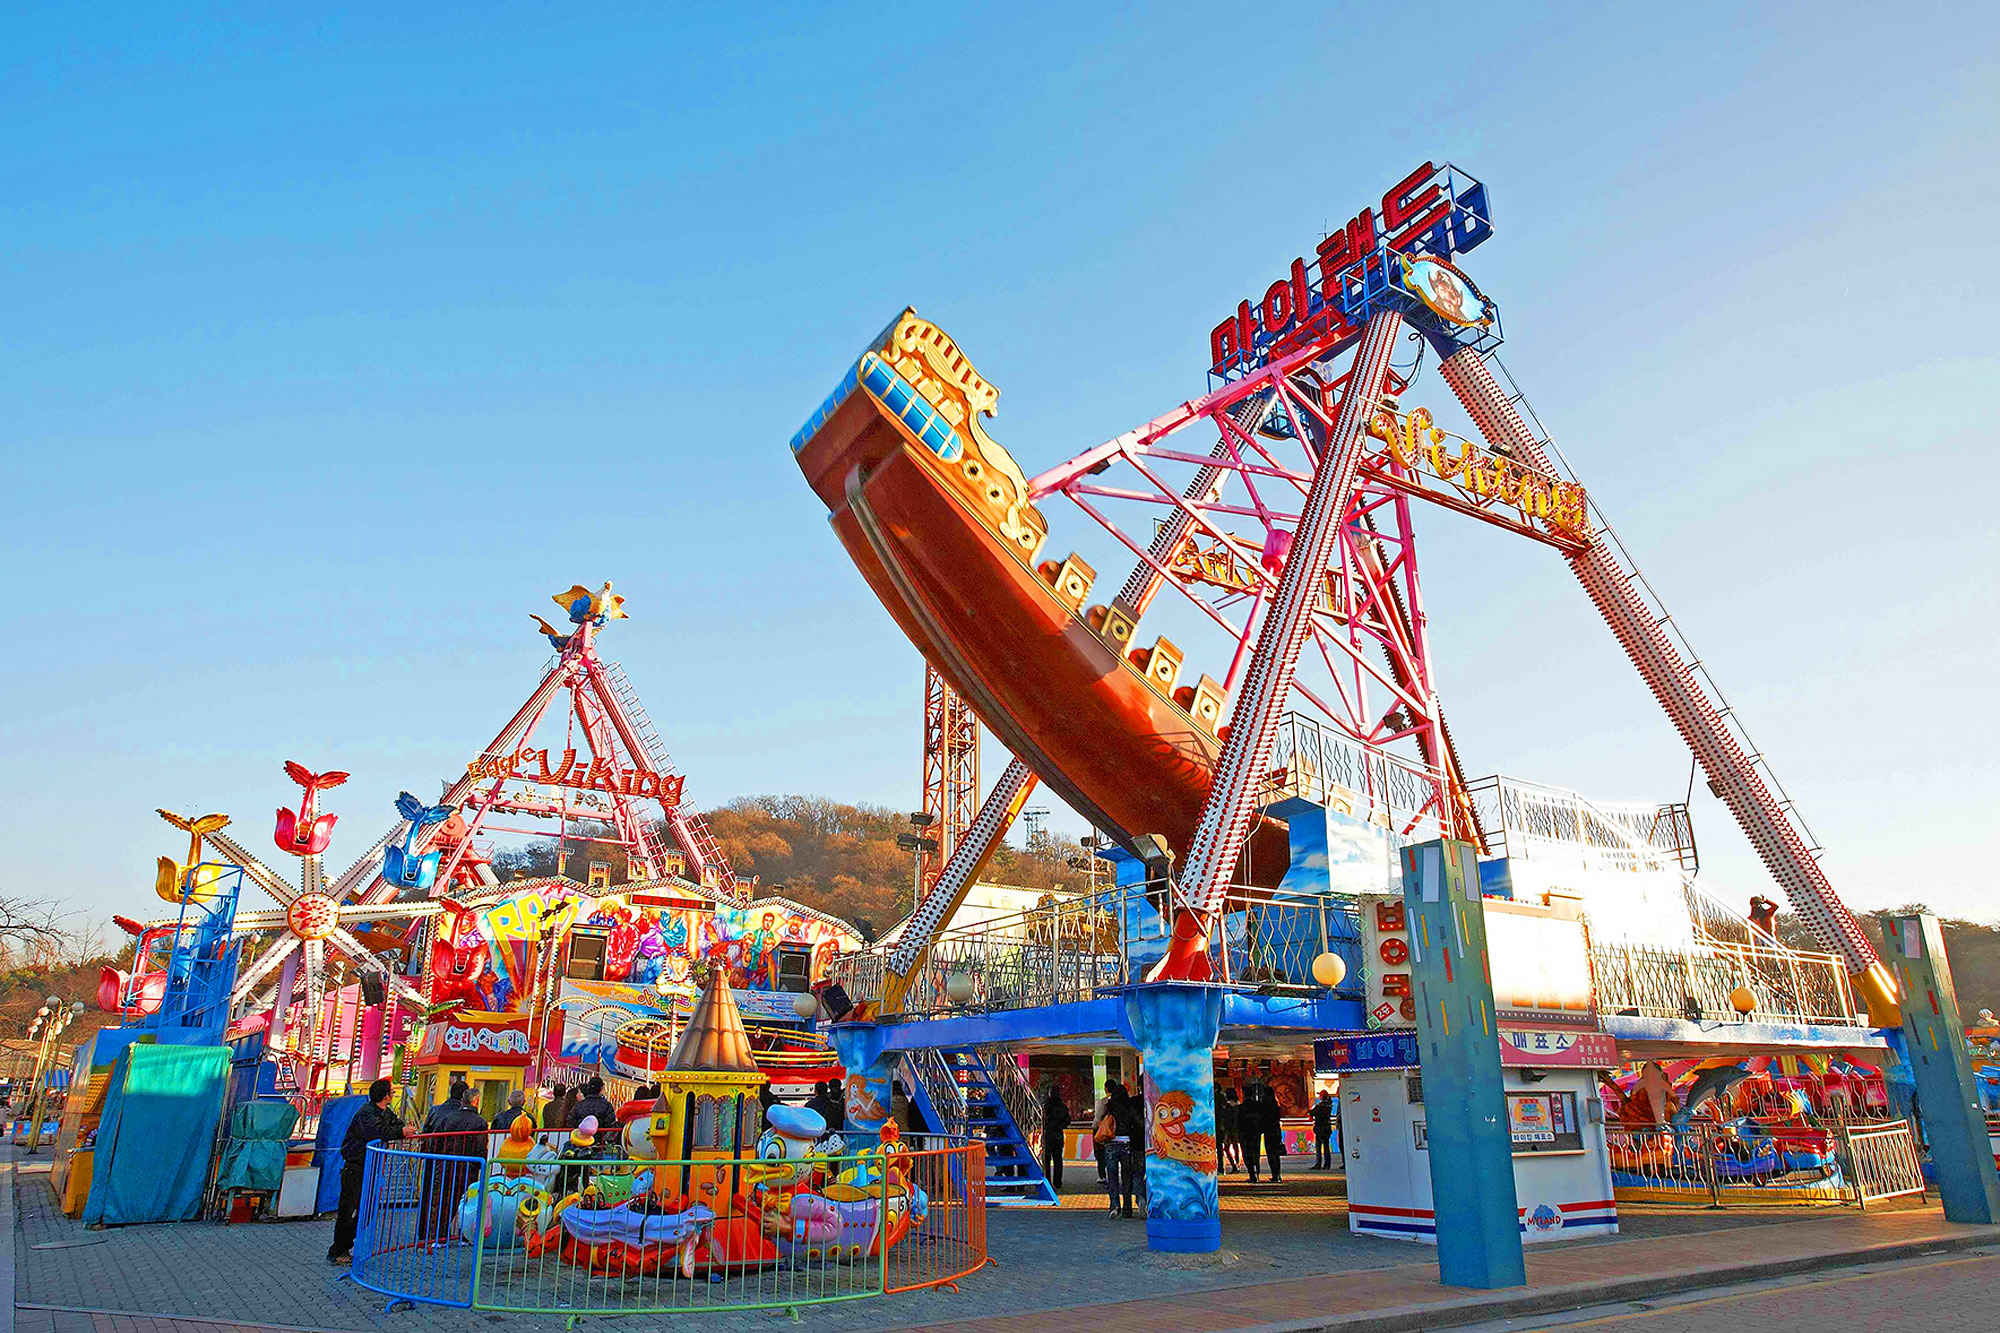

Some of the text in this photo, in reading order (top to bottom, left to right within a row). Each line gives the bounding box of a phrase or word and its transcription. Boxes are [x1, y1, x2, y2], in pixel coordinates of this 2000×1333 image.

[1370, 406, 1590, 536] Viking
[467, 747, 537, 783] Eagle
[536, 748, 686, 808] Viking
[1355, 1037, 1417, 1063] 바이킹
[1511, 1032, 1570, 1050] 매표소
[1527, 1215, 1561, 1226] MYLAND
